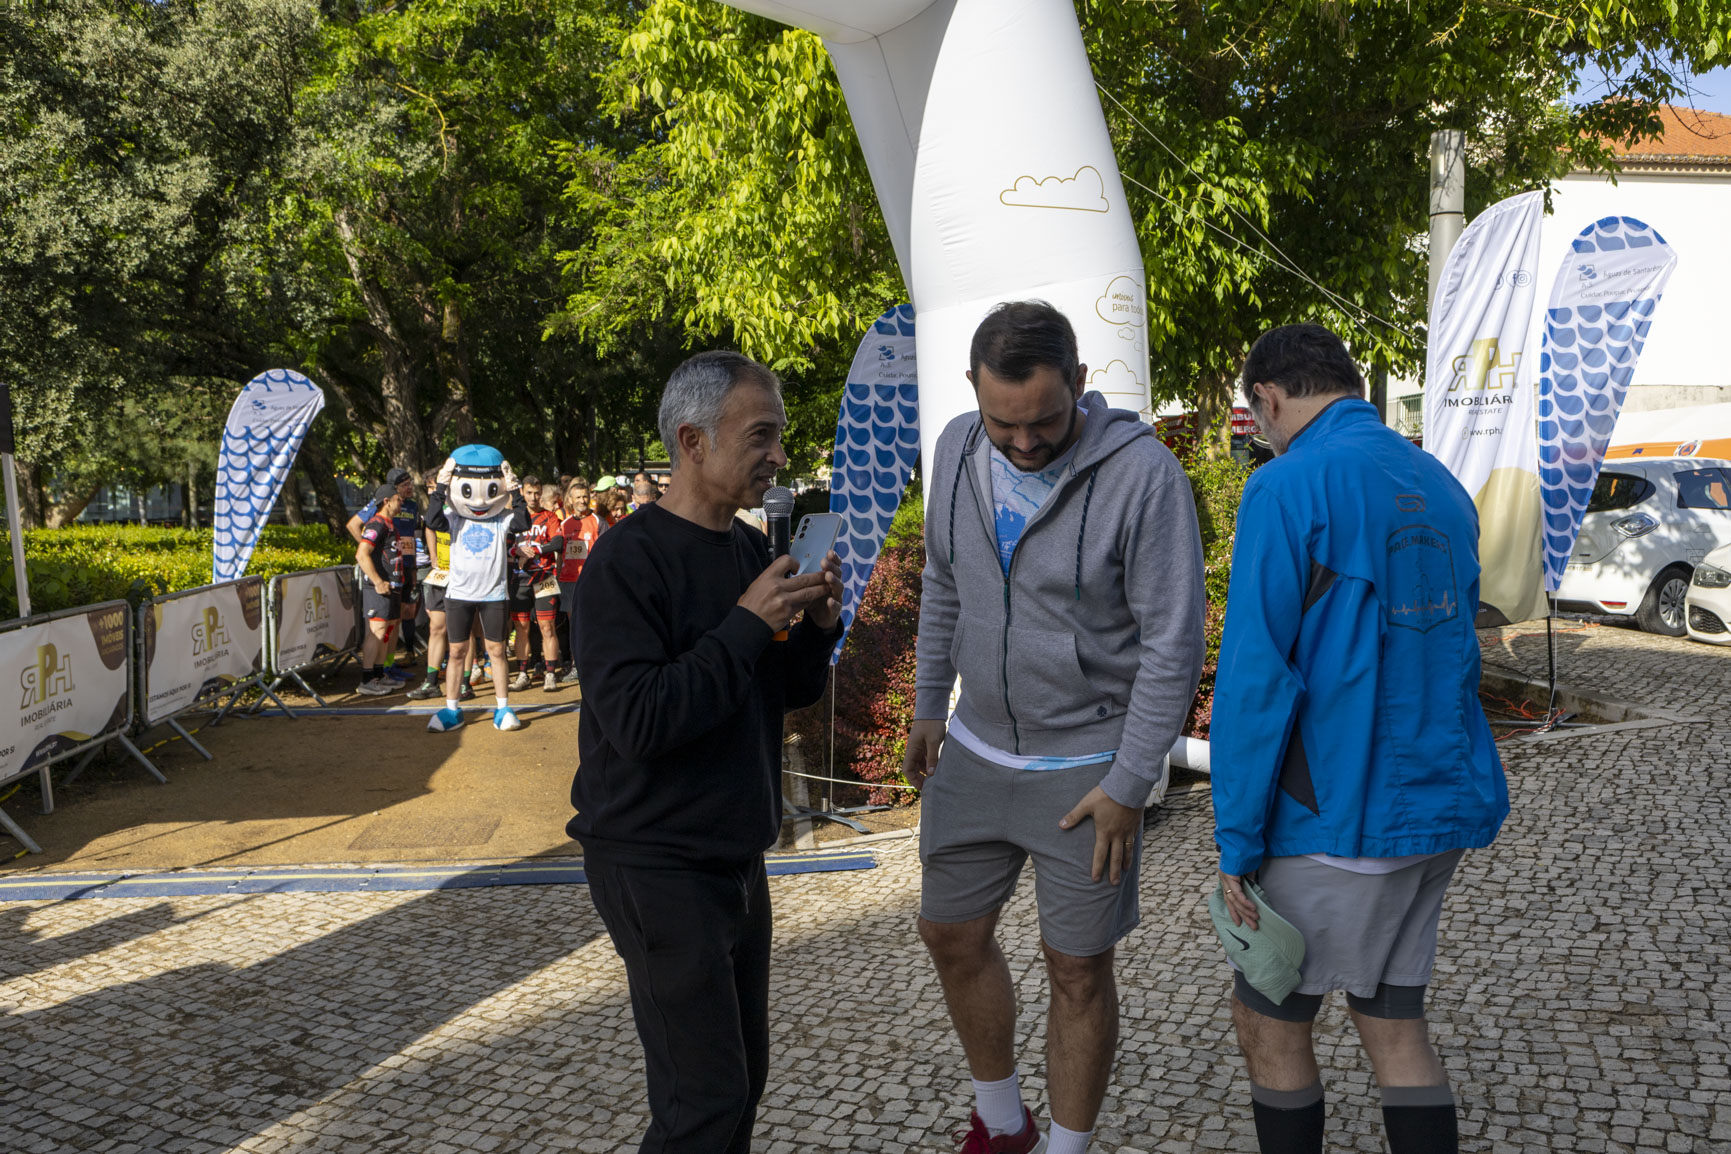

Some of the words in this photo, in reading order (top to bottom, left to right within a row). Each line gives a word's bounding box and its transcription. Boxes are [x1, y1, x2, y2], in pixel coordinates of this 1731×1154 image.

[1112, 303, 1130, 312] para
[569, 545, 583, 553] 139
[98, 611, 123, 630] +1000
